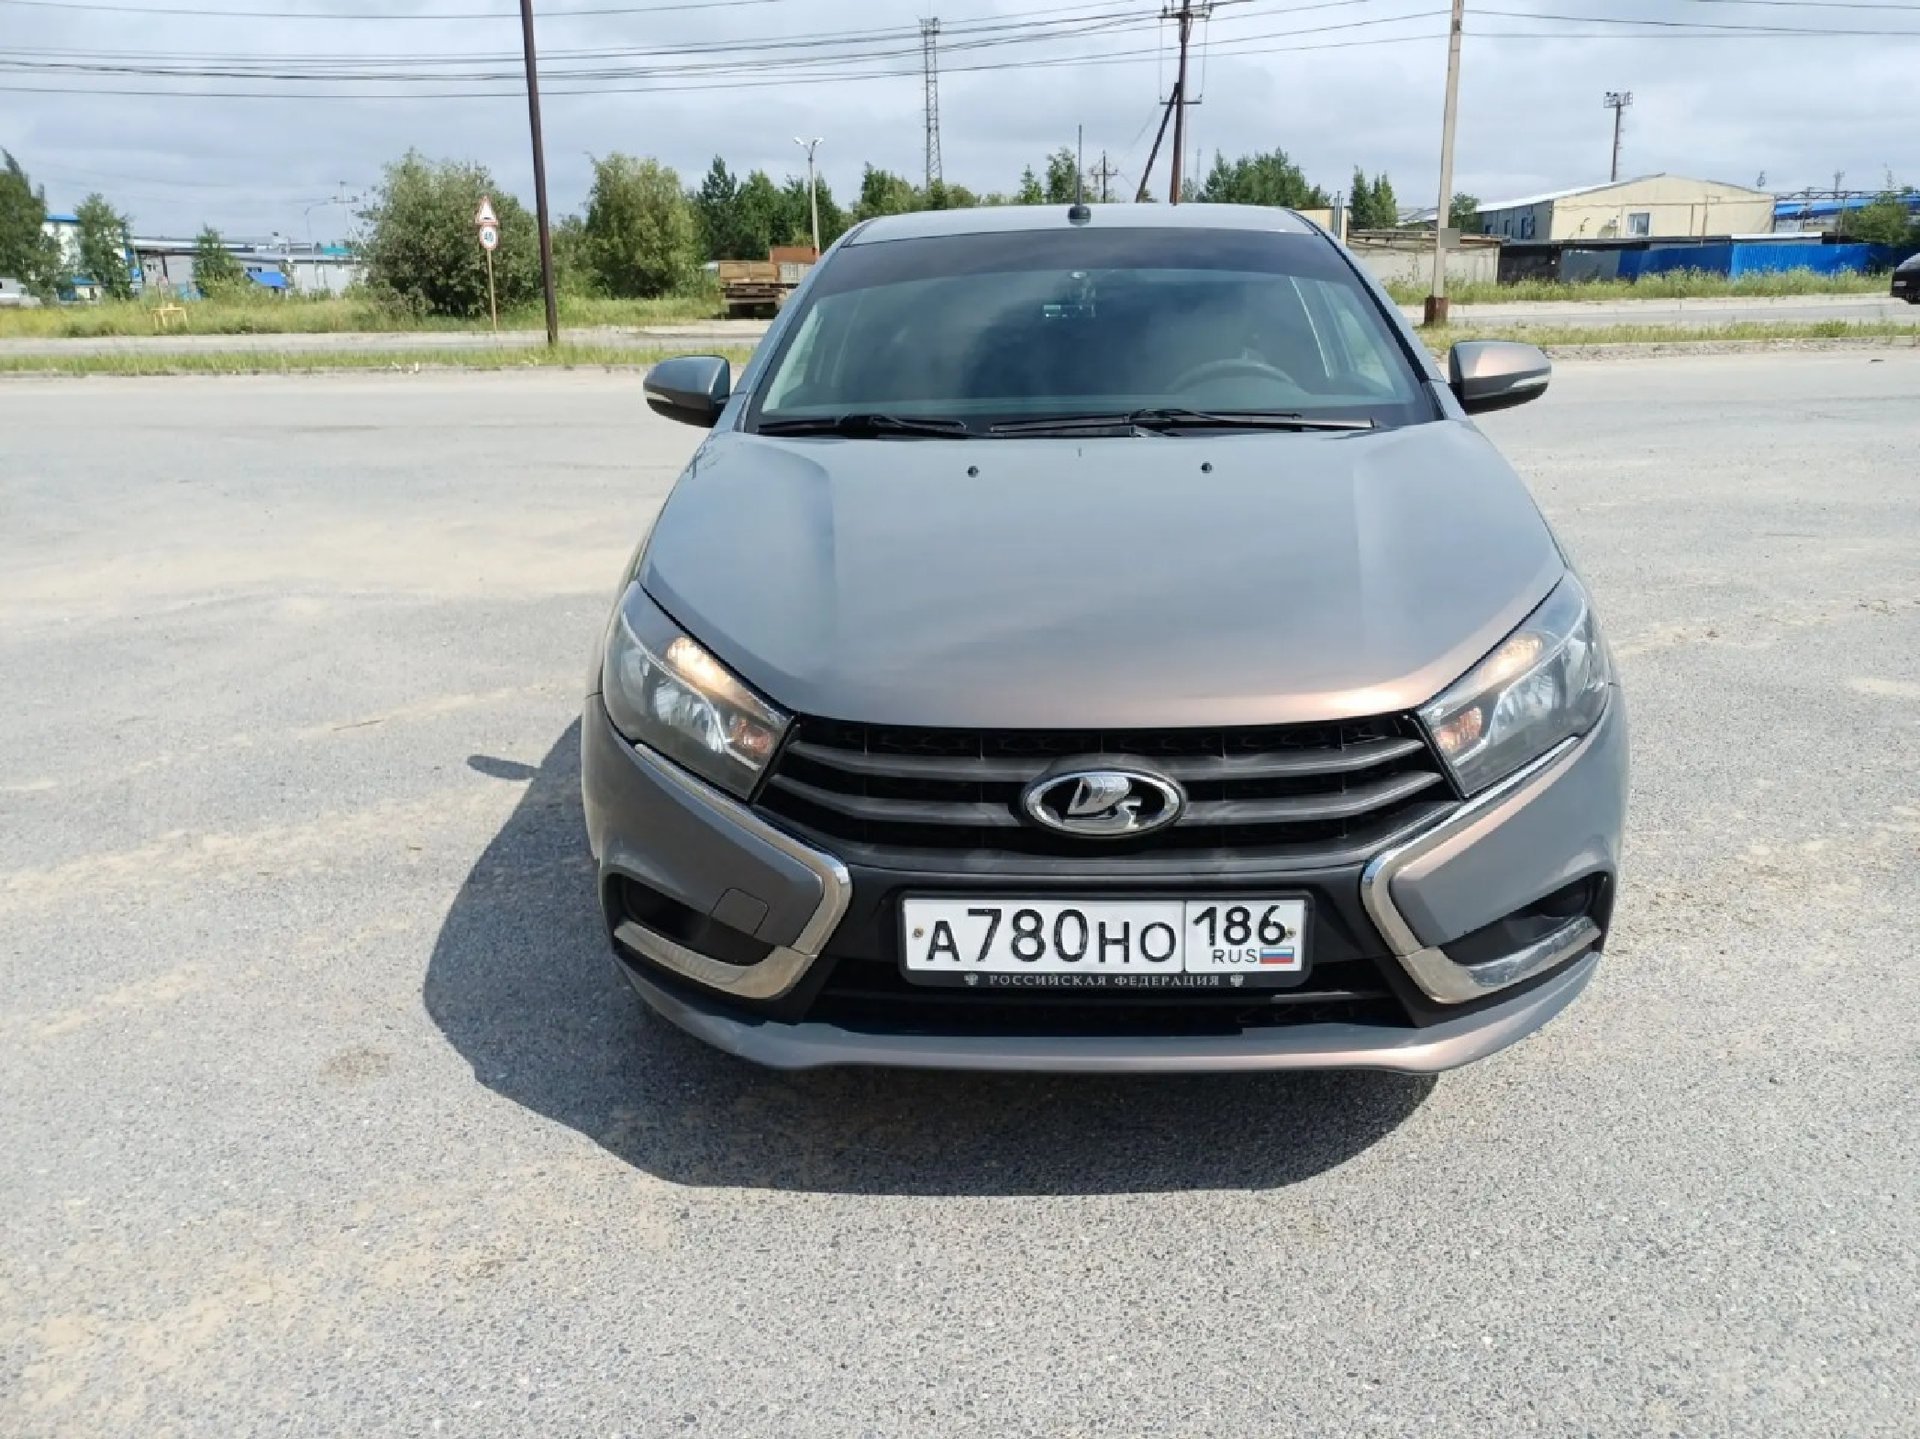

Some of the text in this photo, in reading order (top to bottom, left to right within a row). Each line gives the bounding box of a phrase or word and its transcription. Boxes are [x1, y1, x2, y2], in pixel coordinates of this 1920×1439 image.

[925, 904, 1287, 963] А780НО 186
[1211, 948, 1258, 964] RUS
[988, 974, 1220, 988] РОССИЙСКАЯ ФЕДЕРАЦИЯ
